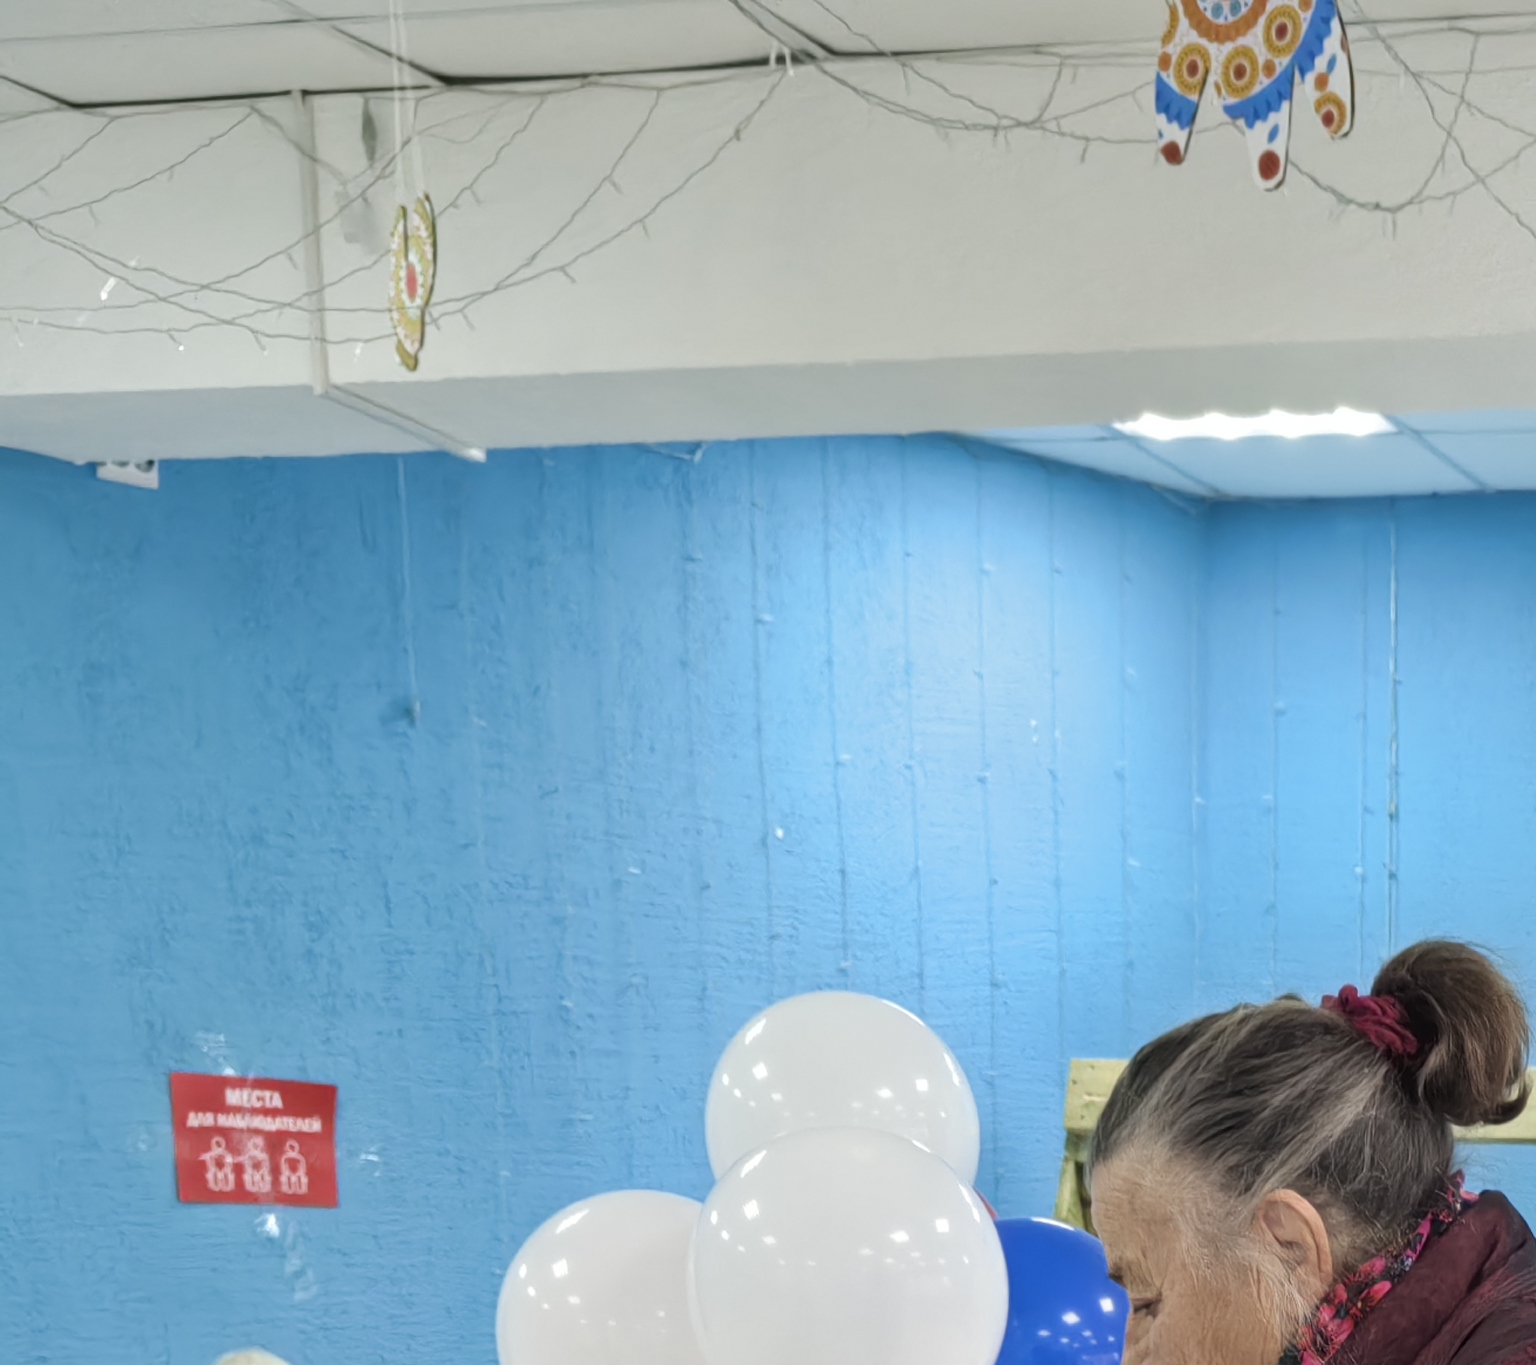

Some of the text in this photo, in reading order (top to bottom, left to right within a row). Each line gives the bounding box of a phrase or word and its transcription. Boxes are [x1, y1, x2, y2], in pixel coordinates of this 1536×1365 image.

[225, 1087, 284, 1109] МЕСТА
[186, 1111, 322, 1133] ДЛЯ НАБЛЮДАТЕЛЕЙ
